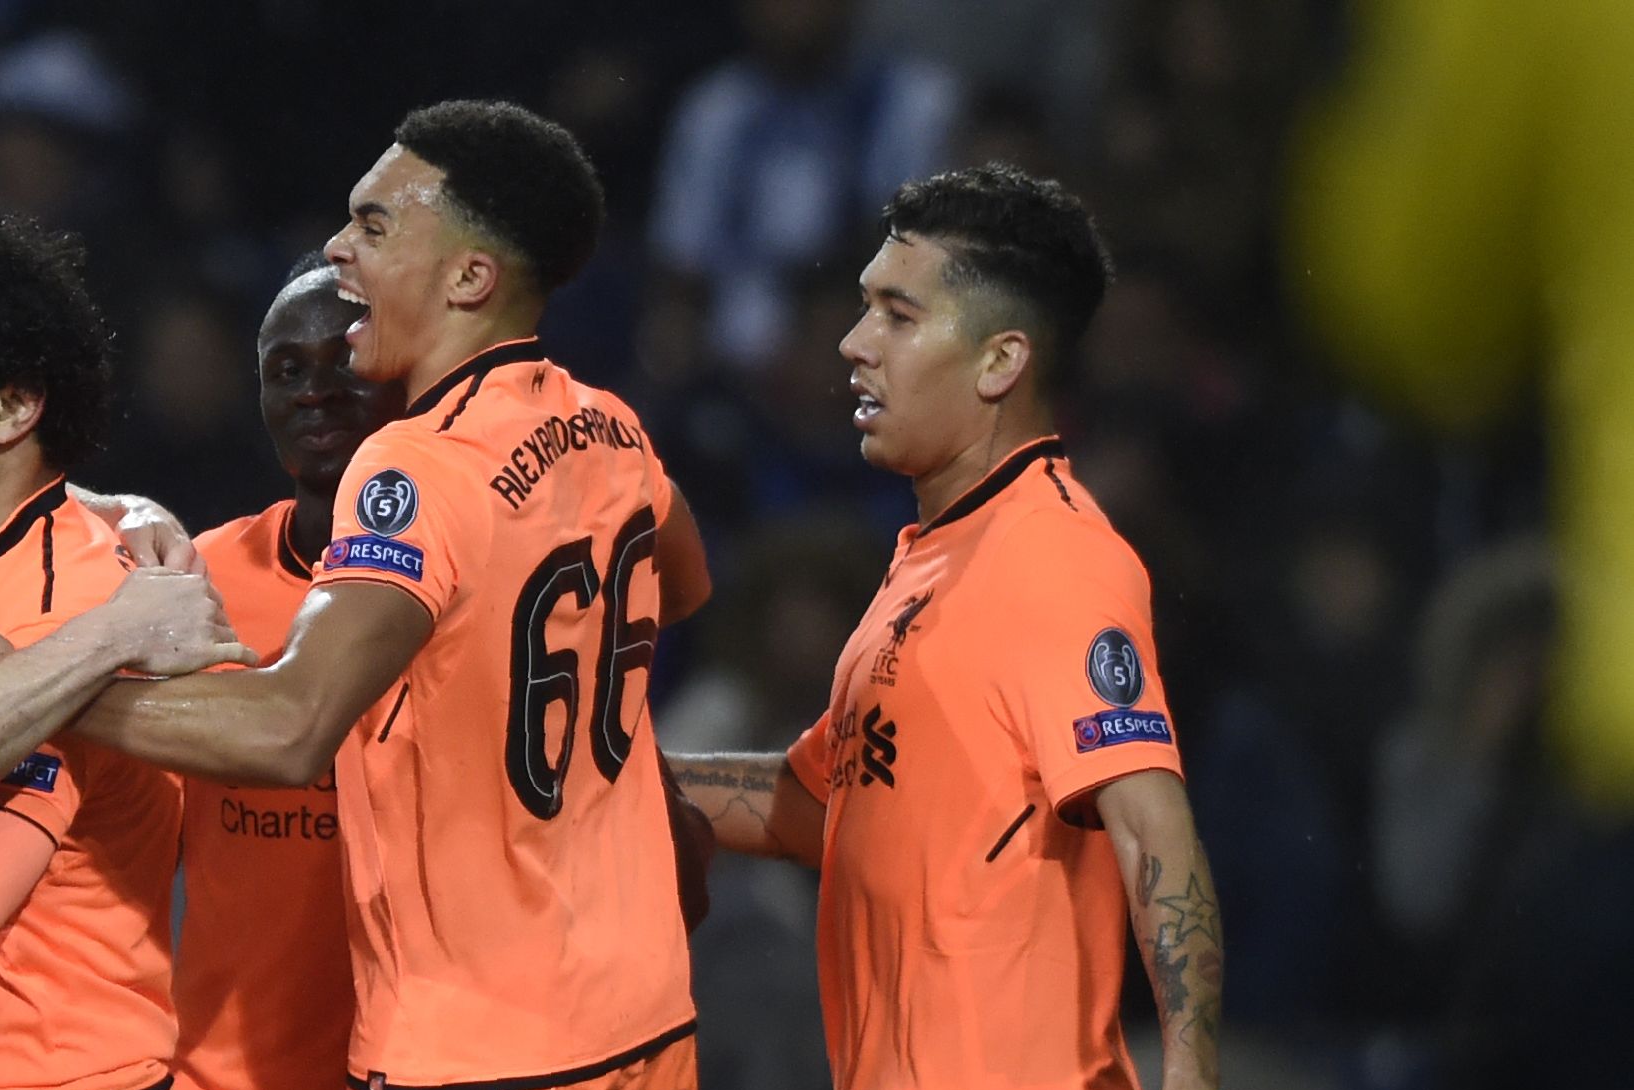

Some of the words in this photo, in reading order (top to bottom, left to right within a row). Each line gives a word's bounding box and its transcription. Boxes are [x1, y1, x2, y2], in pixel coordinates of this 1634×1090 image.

[377, 499, 393, 517] 5
[350, 543, 423, 572] RESPECT
[505, 503, 662, 821] 66
[1114, 666, 1126, 686] 5
[1102, 717, 1168, 737] RESPECT
